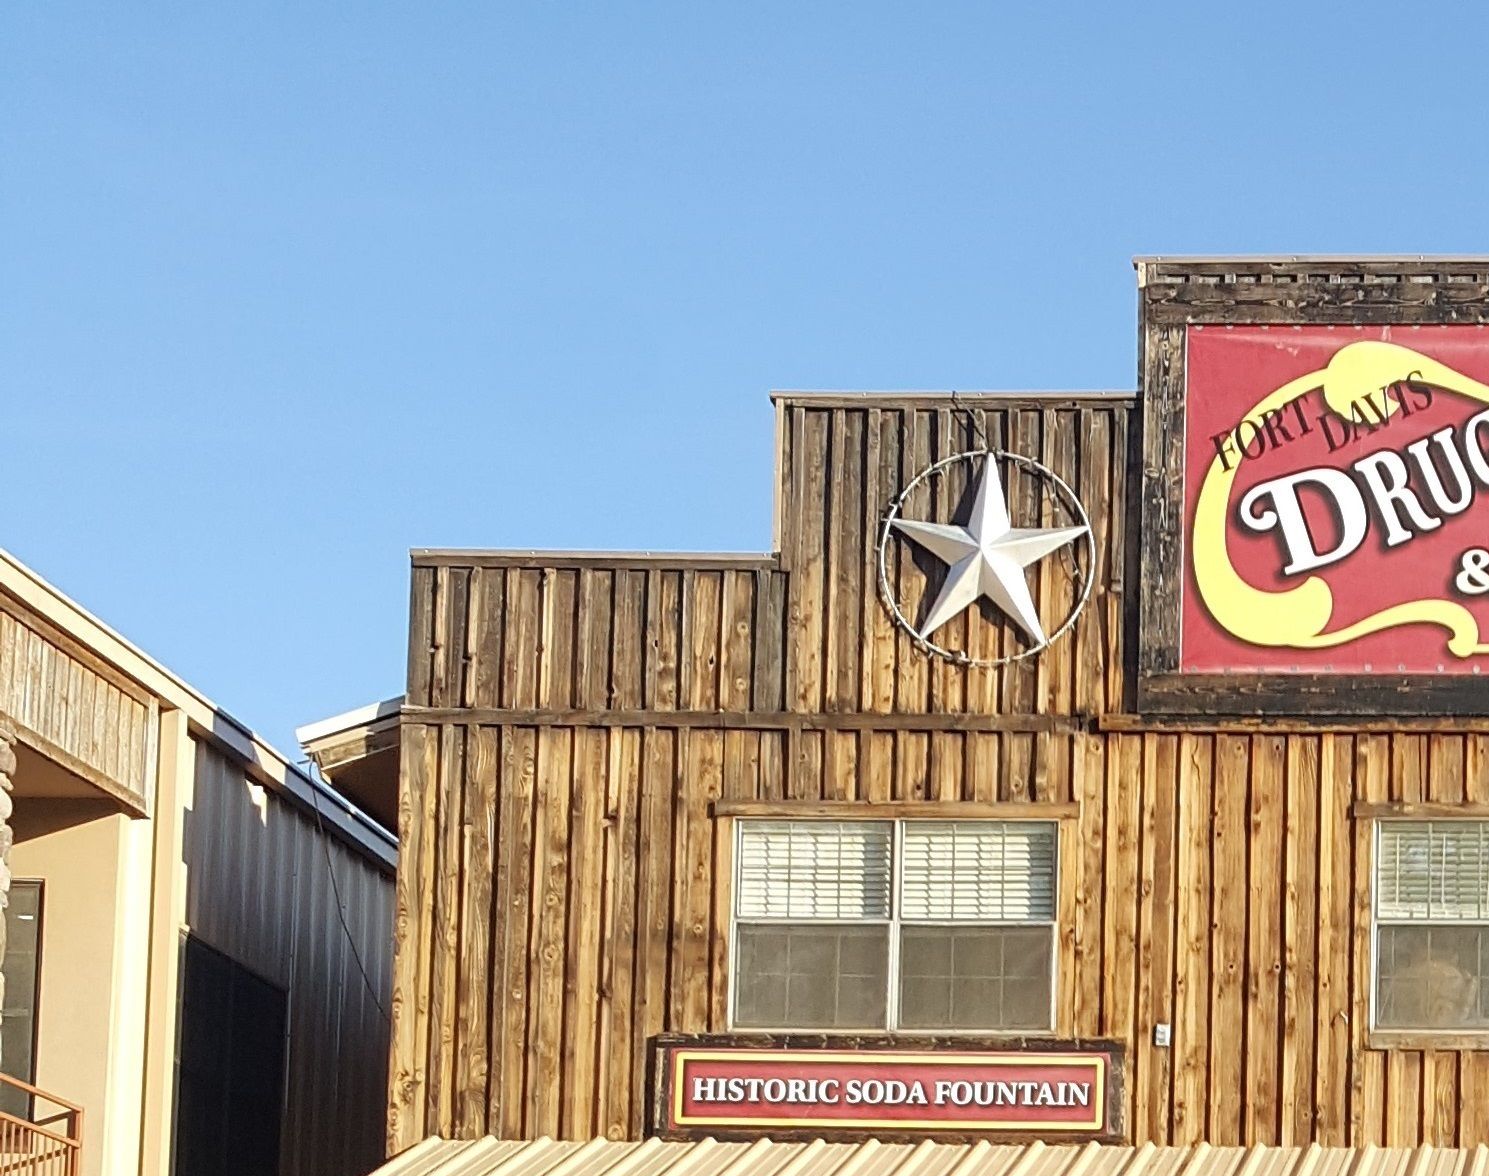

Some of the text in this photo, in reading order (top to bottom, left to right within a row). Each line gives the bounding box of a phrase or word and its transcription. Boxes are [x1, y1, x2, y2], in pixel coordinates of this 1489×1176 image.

[1209, 369, 1435, 473] FORT DAVIS
[692, 1076, 1090, 1107] HISTORIC SODA FOUNTAIN
